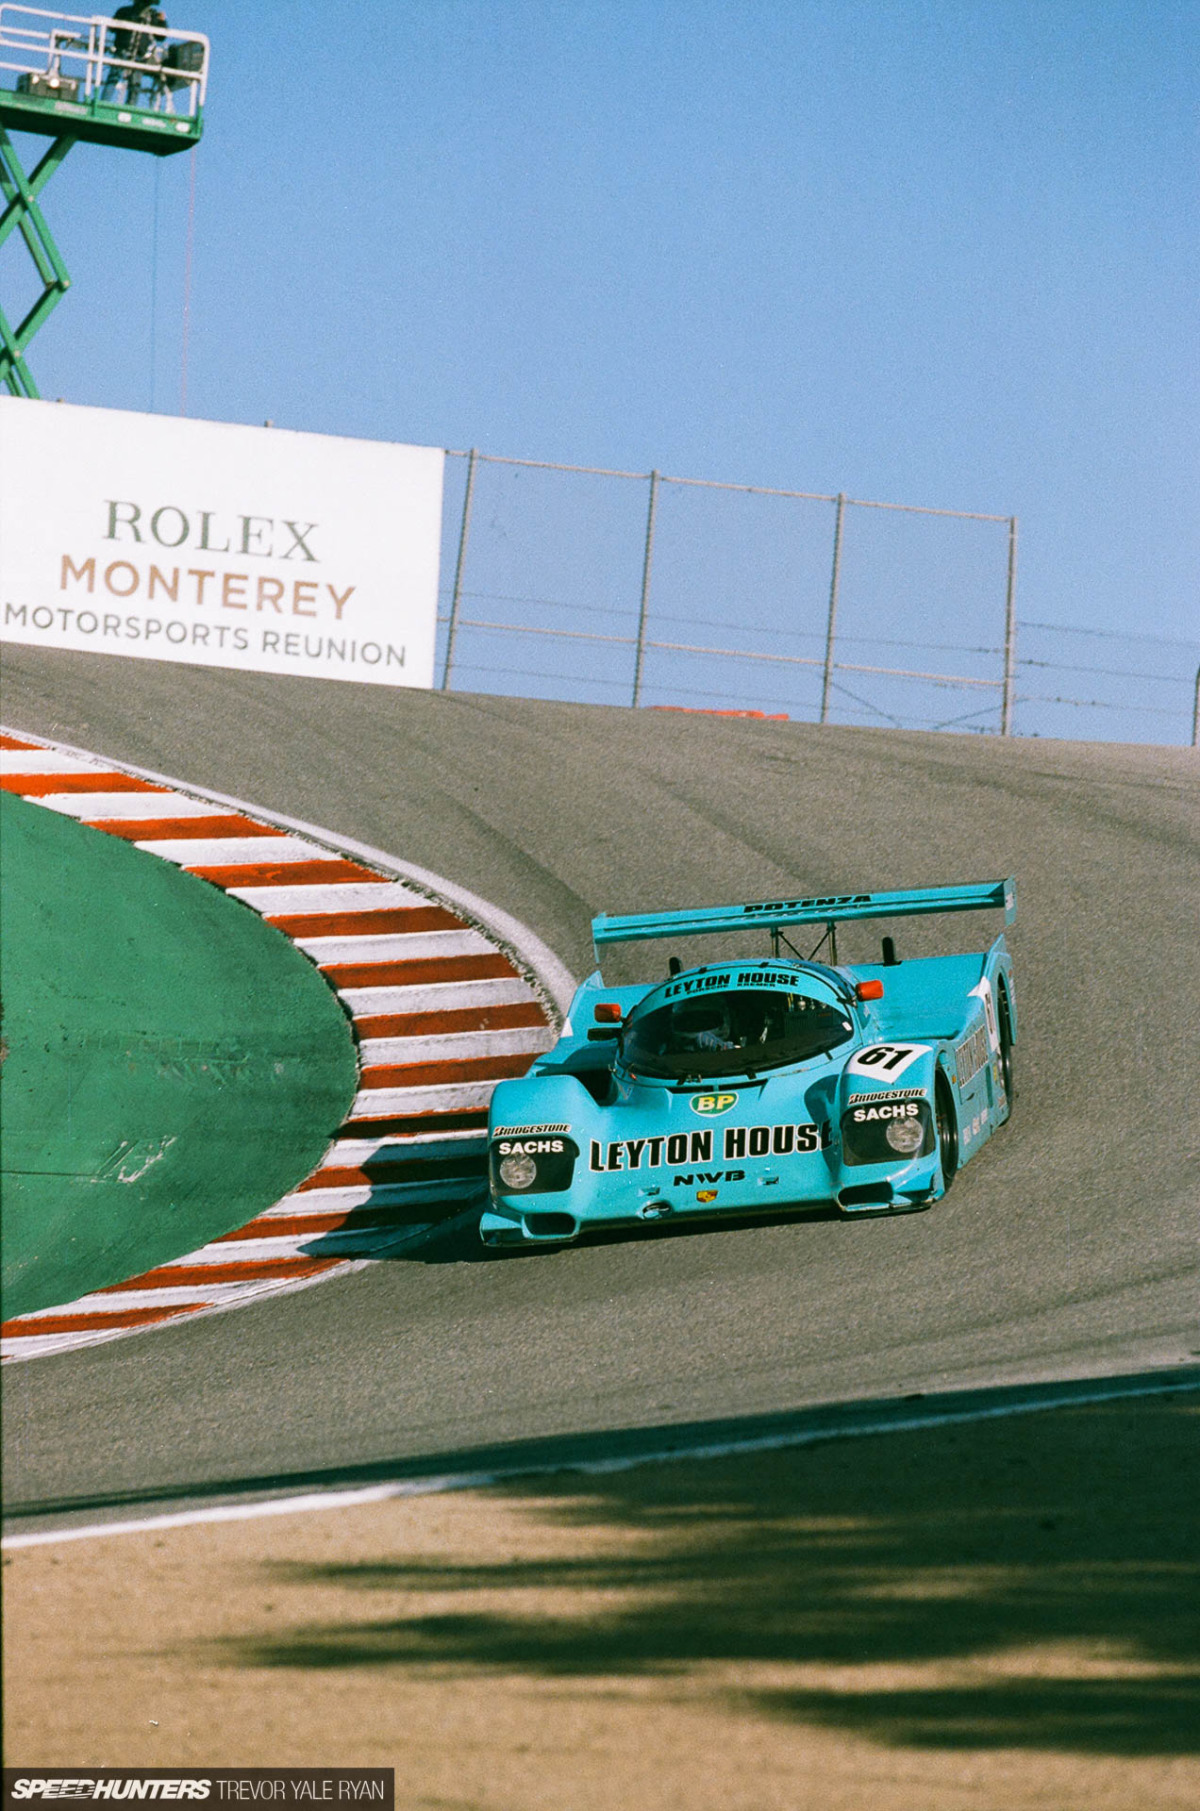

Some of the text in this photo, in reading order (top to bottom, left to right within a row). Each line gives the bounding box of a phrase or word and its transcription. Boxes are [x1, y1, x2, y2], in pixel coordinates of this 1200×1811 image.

[103, 499, 320, 563] ROLEX
[60, 554, 356, 620] MONTEREY
[4, 603, 406, 668] MOTORSPORTS REUNION
[743, 894, 872, 914] POTENZA
[664, 972, 799, 998] LEYTON HOUSE
[857, 1046, 913, 1071] 61
[697, 1095, 735, 1112] BP
[848, 1088, 926, 1105] BRIDGESTONE
[853, 1103, 919, 1123] SACHS
[493, 1124, 570, 1136] BRIDGESTONE
[498, 1140, 564, 1156] SACHS
[590, 1130, 713, 1171] LEYTON
[673, 1170, 746, 1187] NWB
